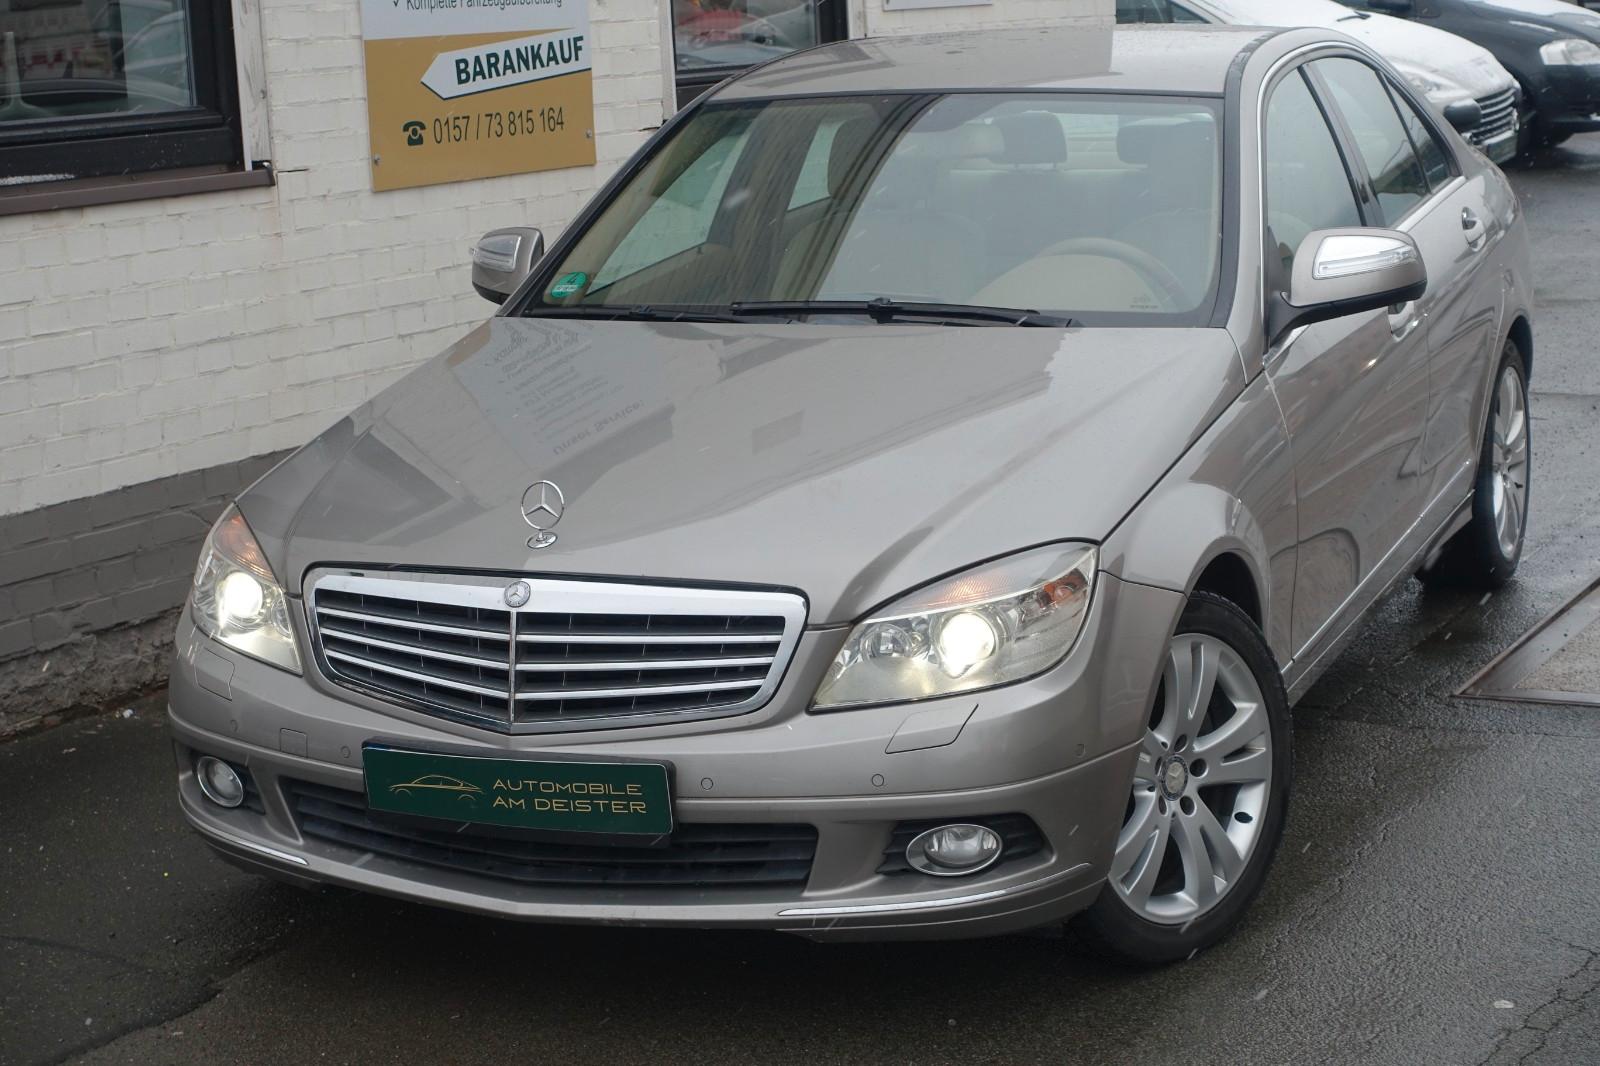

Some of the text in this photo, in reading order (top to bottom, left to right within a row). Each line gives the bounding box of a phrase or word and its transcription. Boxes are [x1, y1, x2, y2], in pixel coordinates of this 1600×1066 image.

[455, 35, 584, 85] BARANKAUF
[433, 115, 470, 144] 0157
[485, 112, 503, 138] 73
[508, 111, 535, 136] 815
[540, 106, 564, 132] 164
[493, 778, 643, 796] AUTOMOBILE
[493, 796, 647, 813] AM DEISTER
